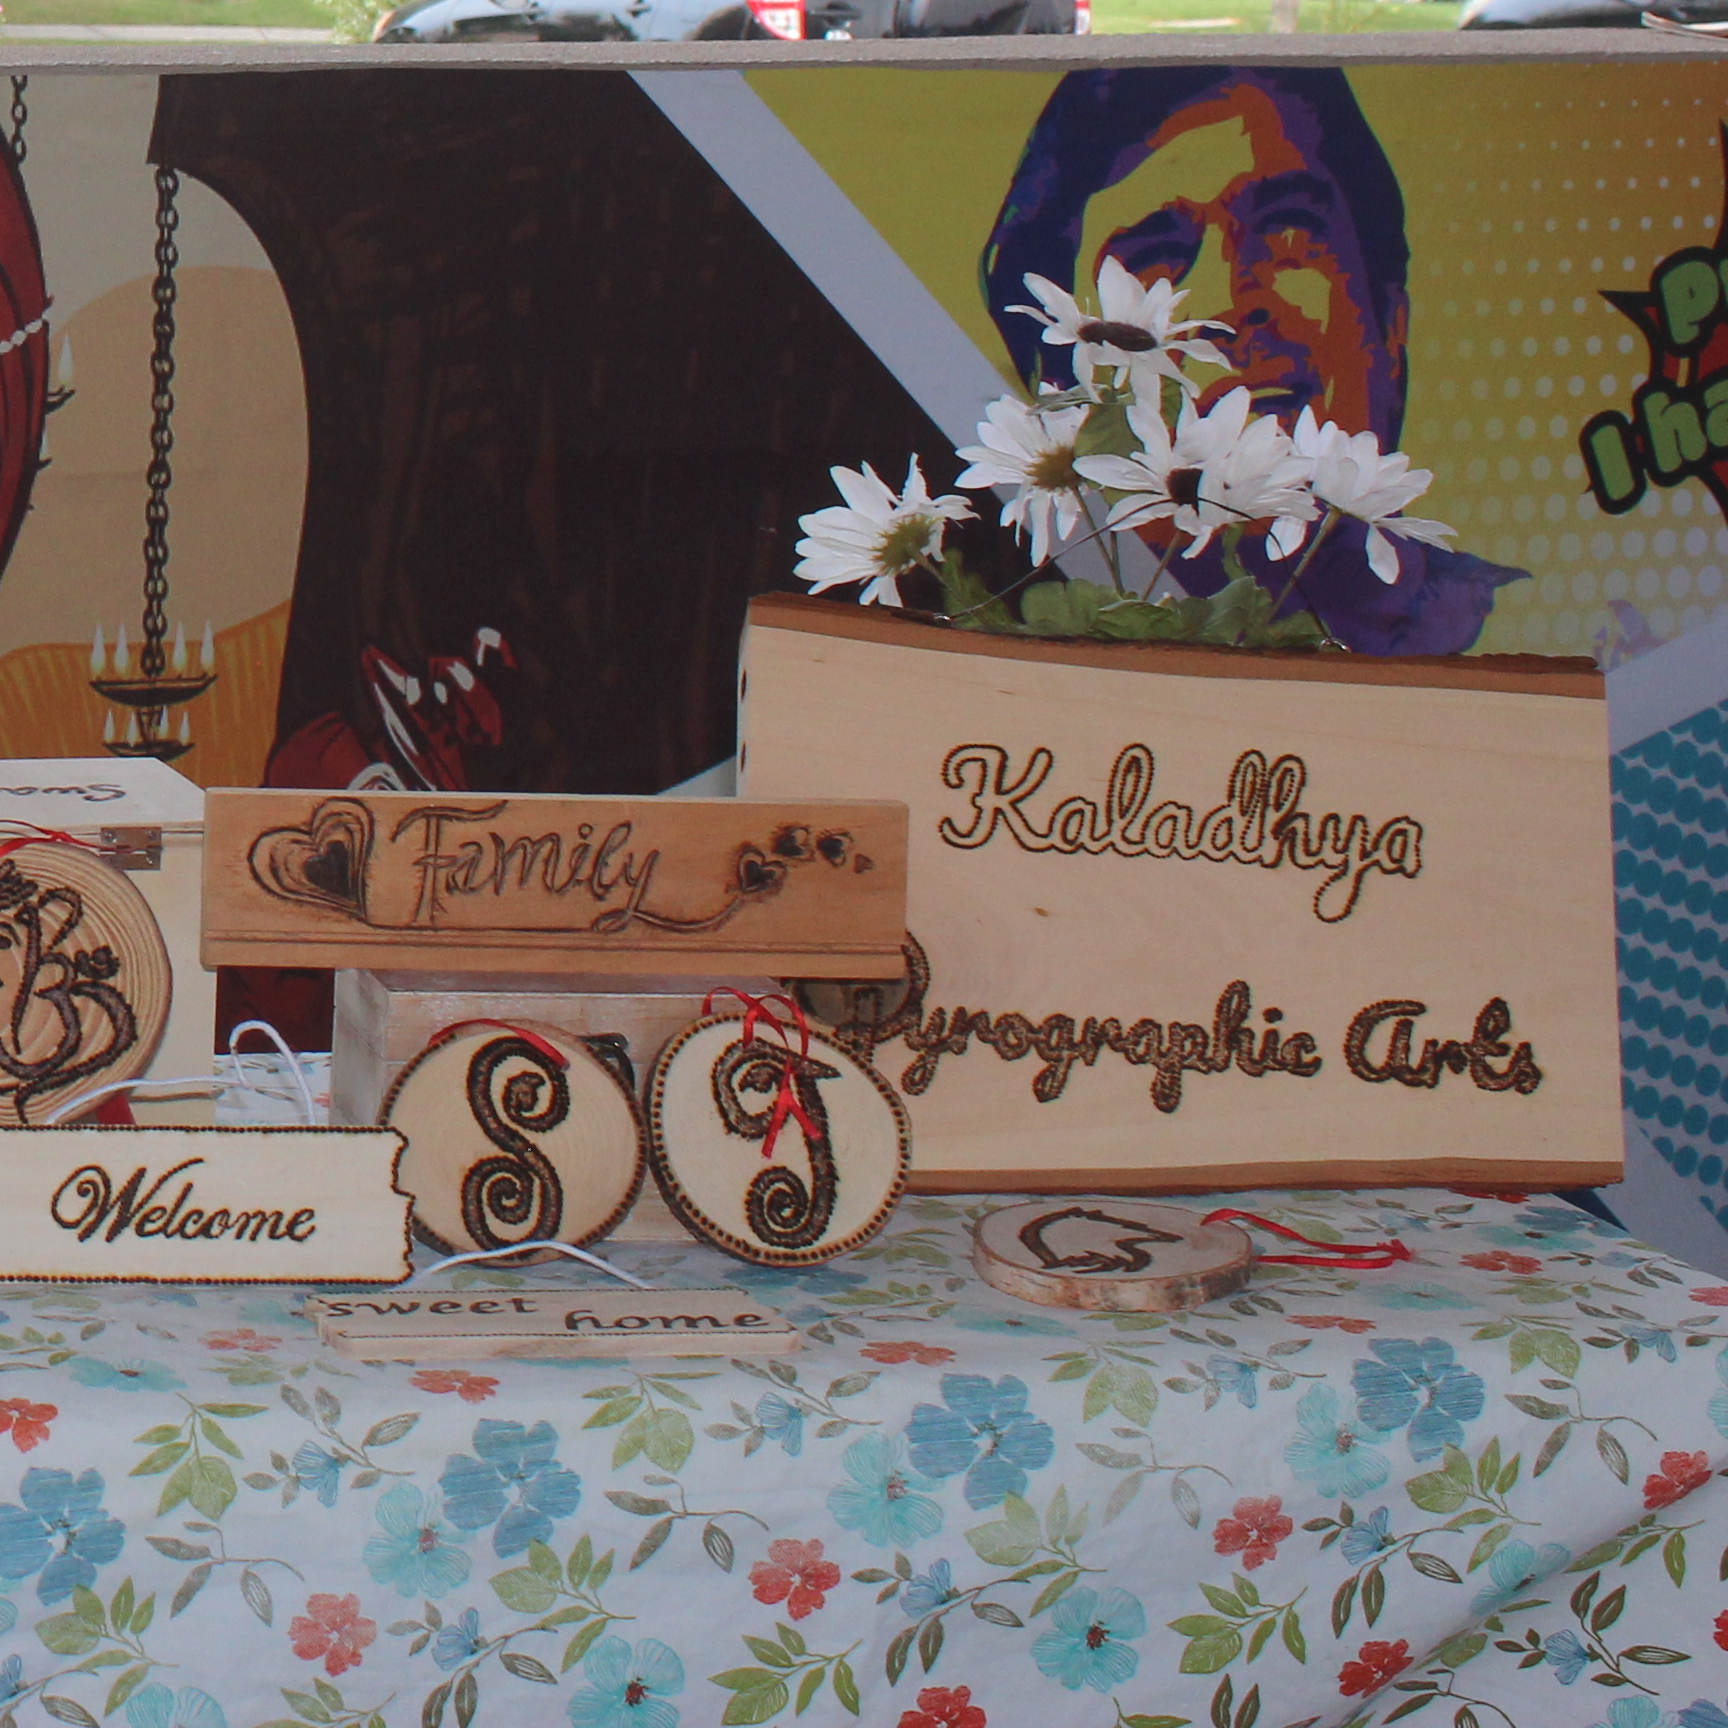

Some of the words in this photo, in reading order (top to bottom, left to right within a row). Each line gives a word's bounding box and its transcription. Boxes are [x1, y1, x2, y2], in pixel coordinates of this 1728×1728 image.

[394, 799, 660, 934] Family
[936, 742, 1425, 924] Kaladhya
[1343, 997, 1545, 1097] Arts
[50, 1156, 318, 1245] Welcome
[462, 1035, 570, 1250] S
[327, 1294, 540, 1317] sweet
[564, 1307, 771, 1332] home
